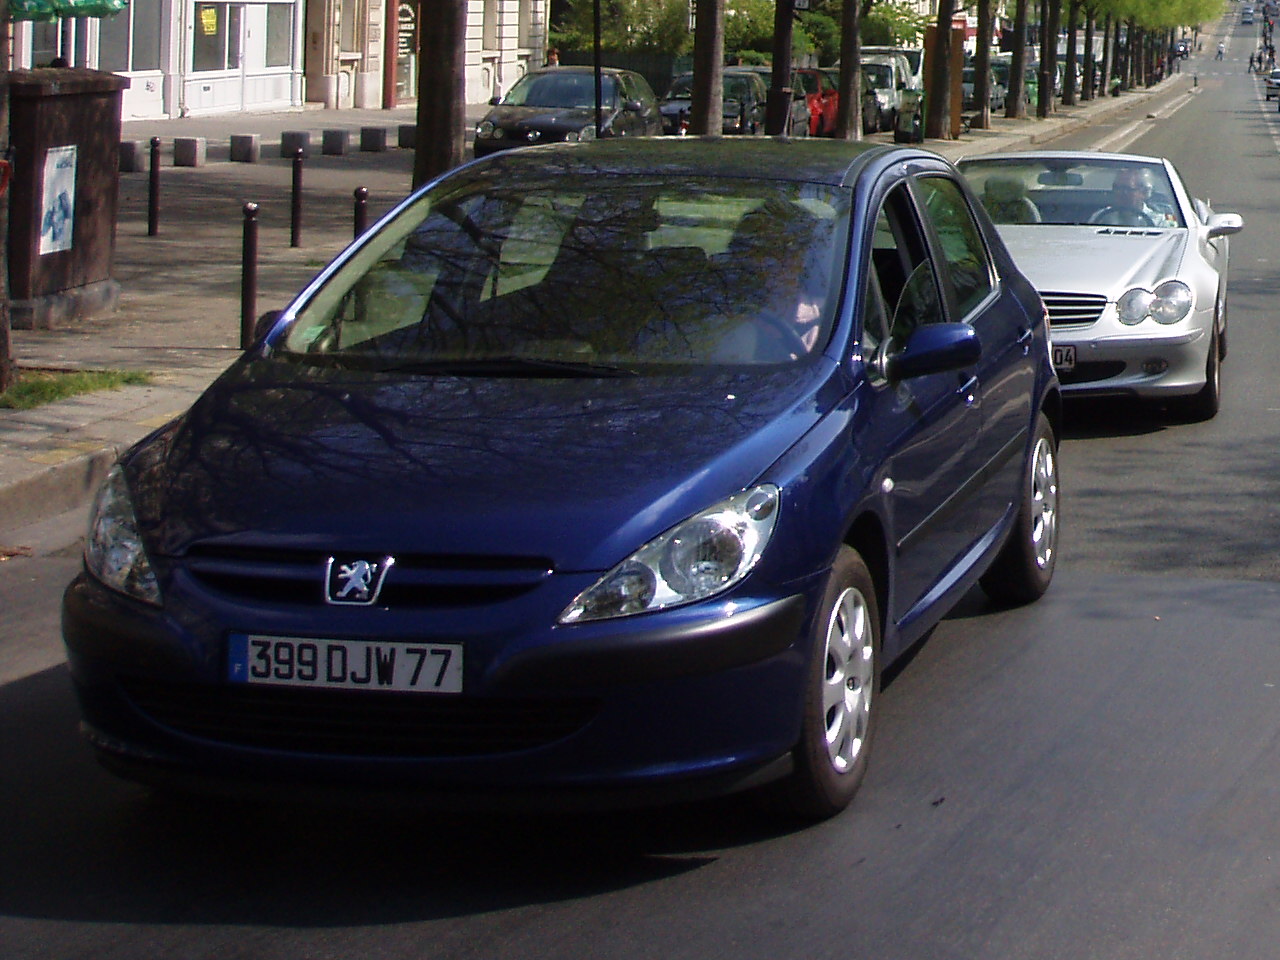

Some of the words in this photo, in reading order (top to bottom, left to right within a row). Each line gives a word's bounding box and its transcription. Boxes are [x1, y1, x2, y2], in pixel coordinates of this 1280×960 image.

[1054, 349, 1073, 365] 04
[250, 639, 318, 681] 399
[327, 644, 396, 685] DJW
[406, 648, 452, 687] 77
